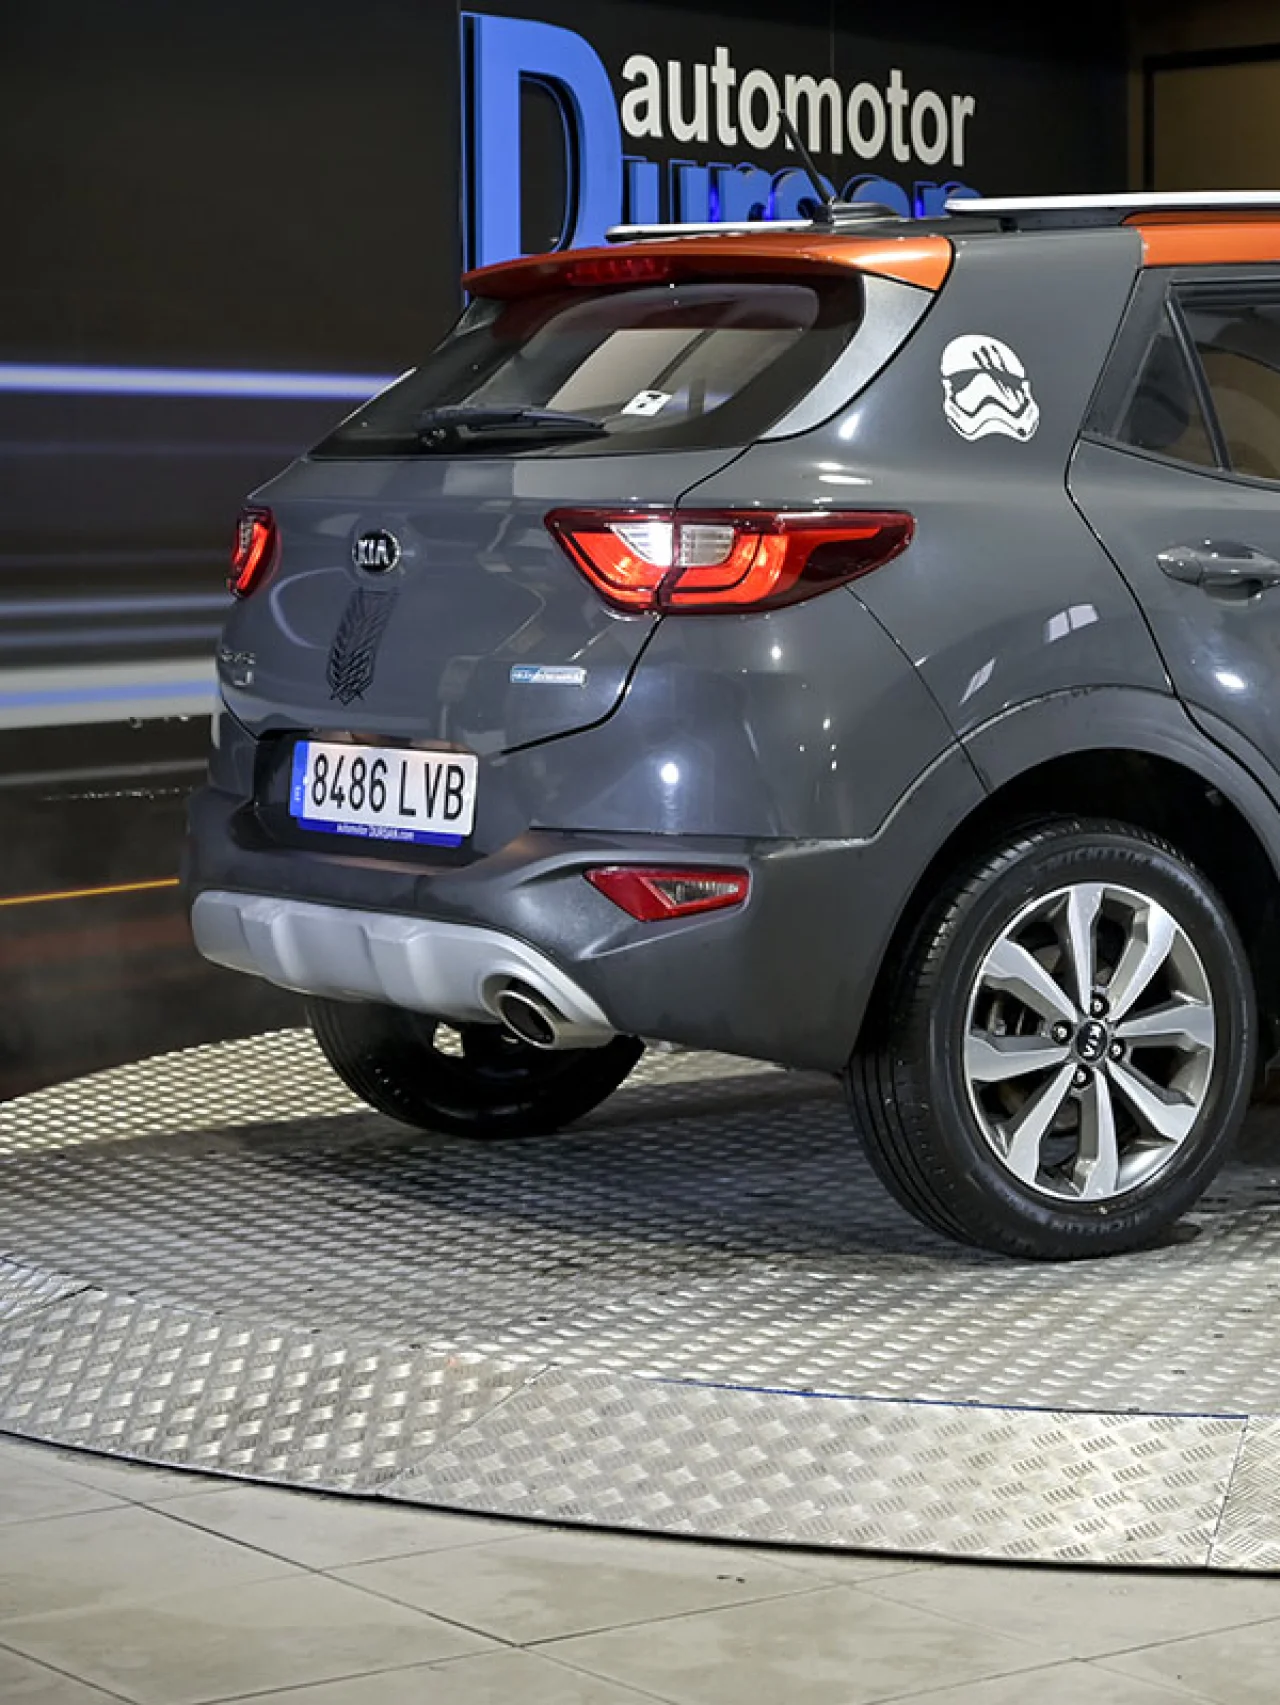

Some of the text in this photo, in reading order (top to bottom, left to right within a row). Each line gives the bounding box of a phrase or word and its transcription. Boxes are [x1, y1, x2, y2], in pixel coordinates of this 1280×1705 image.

[621, 46, 976, 167] automotor
[358, 539, 389, 564] KIA
[311, 752, 466, 821] 8486 LVB
